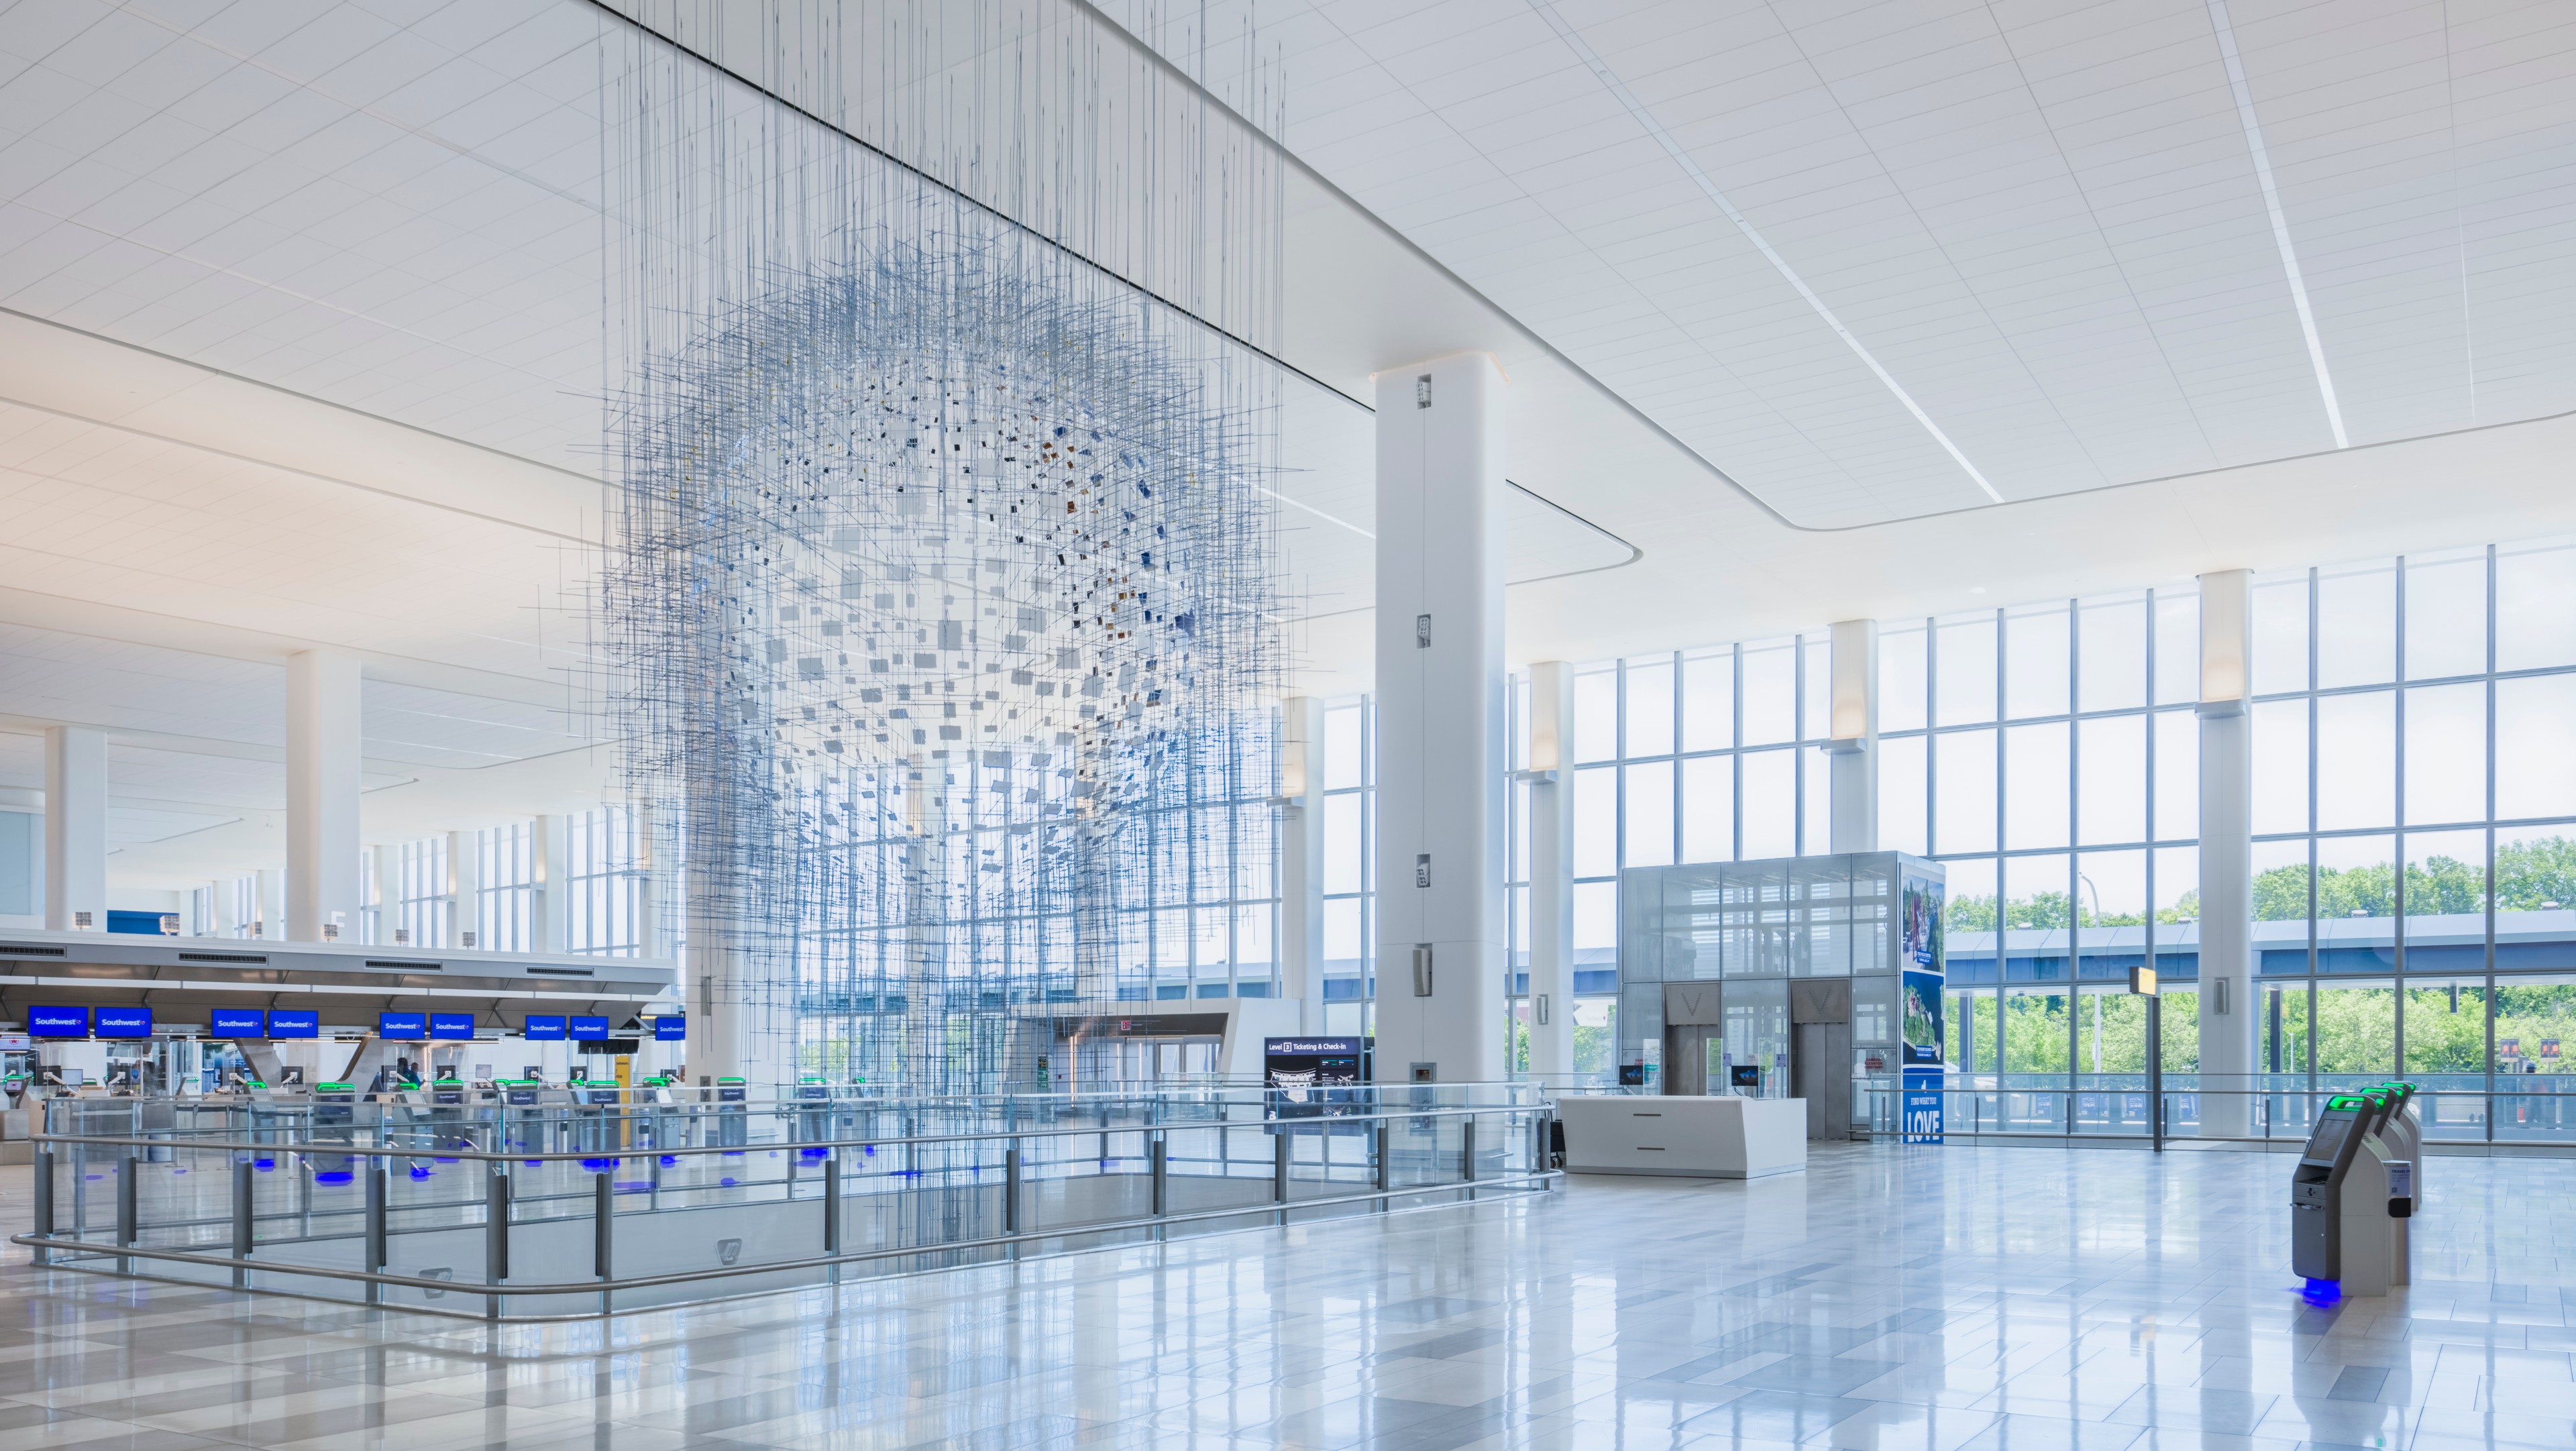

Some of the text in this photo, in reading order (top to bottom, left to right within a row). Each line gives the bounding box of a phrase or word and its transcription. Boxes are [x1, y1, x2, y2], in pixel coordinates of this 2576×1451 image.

[1911, 1097, 1919, 1106] FIND
[1919, 1097, 1929, 1105] WHAT
[1907, 1110, 1939, 1142] LOVE
